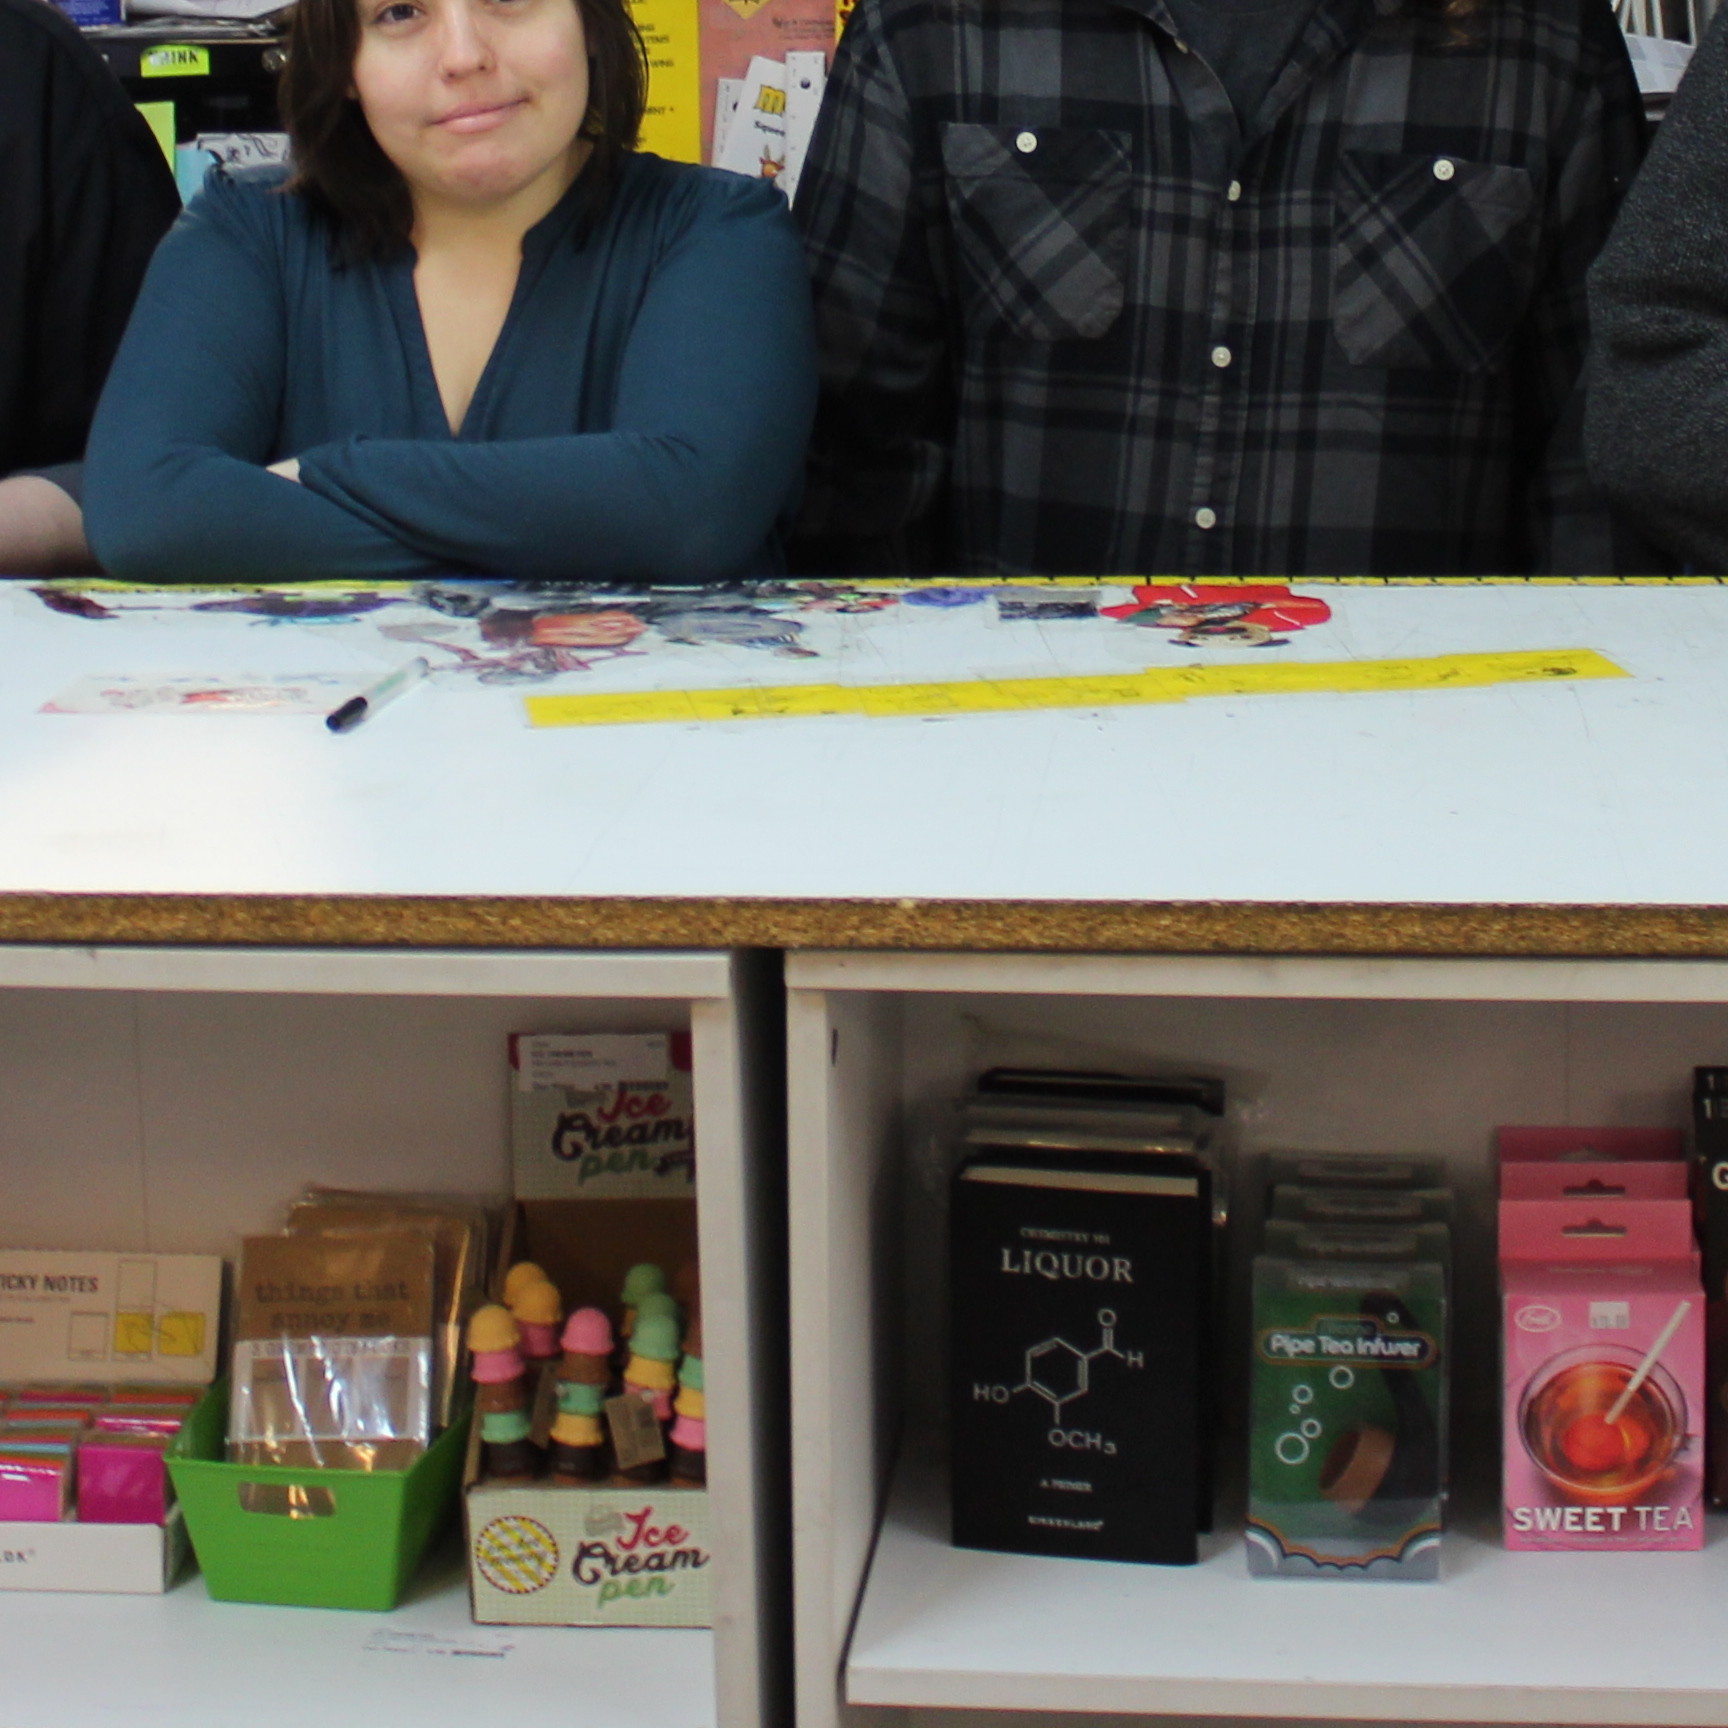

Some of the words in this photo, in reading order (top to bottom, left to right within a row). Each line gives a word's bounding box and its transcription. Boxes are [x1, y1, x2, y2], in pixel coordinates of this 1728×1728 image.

[596, 1090, 673, 1123] Ice
[551, 1111, 691, 1162] Cream
[1000, 1246, 1134, 1283] LIQUOR
[43, 1273, 99, 1293] NOTES
[255, 1282, 344, 1306] things
[353, 1280, 410, 1302] that
[1270, 1333, 1314, 1360] Pipe
[1317, 1334, 1355, 1357] Tea
[973, 1382, 1011, 1404] HO
[615, 1505, 690, 1551] Ice
[1511, 1505, 1627, 1534] SWEET
[1635, 1505, 1695, 1533] TEA
[572, 1540, 711, 1586] Cream
[597, 1576, 676, 1610] pen
